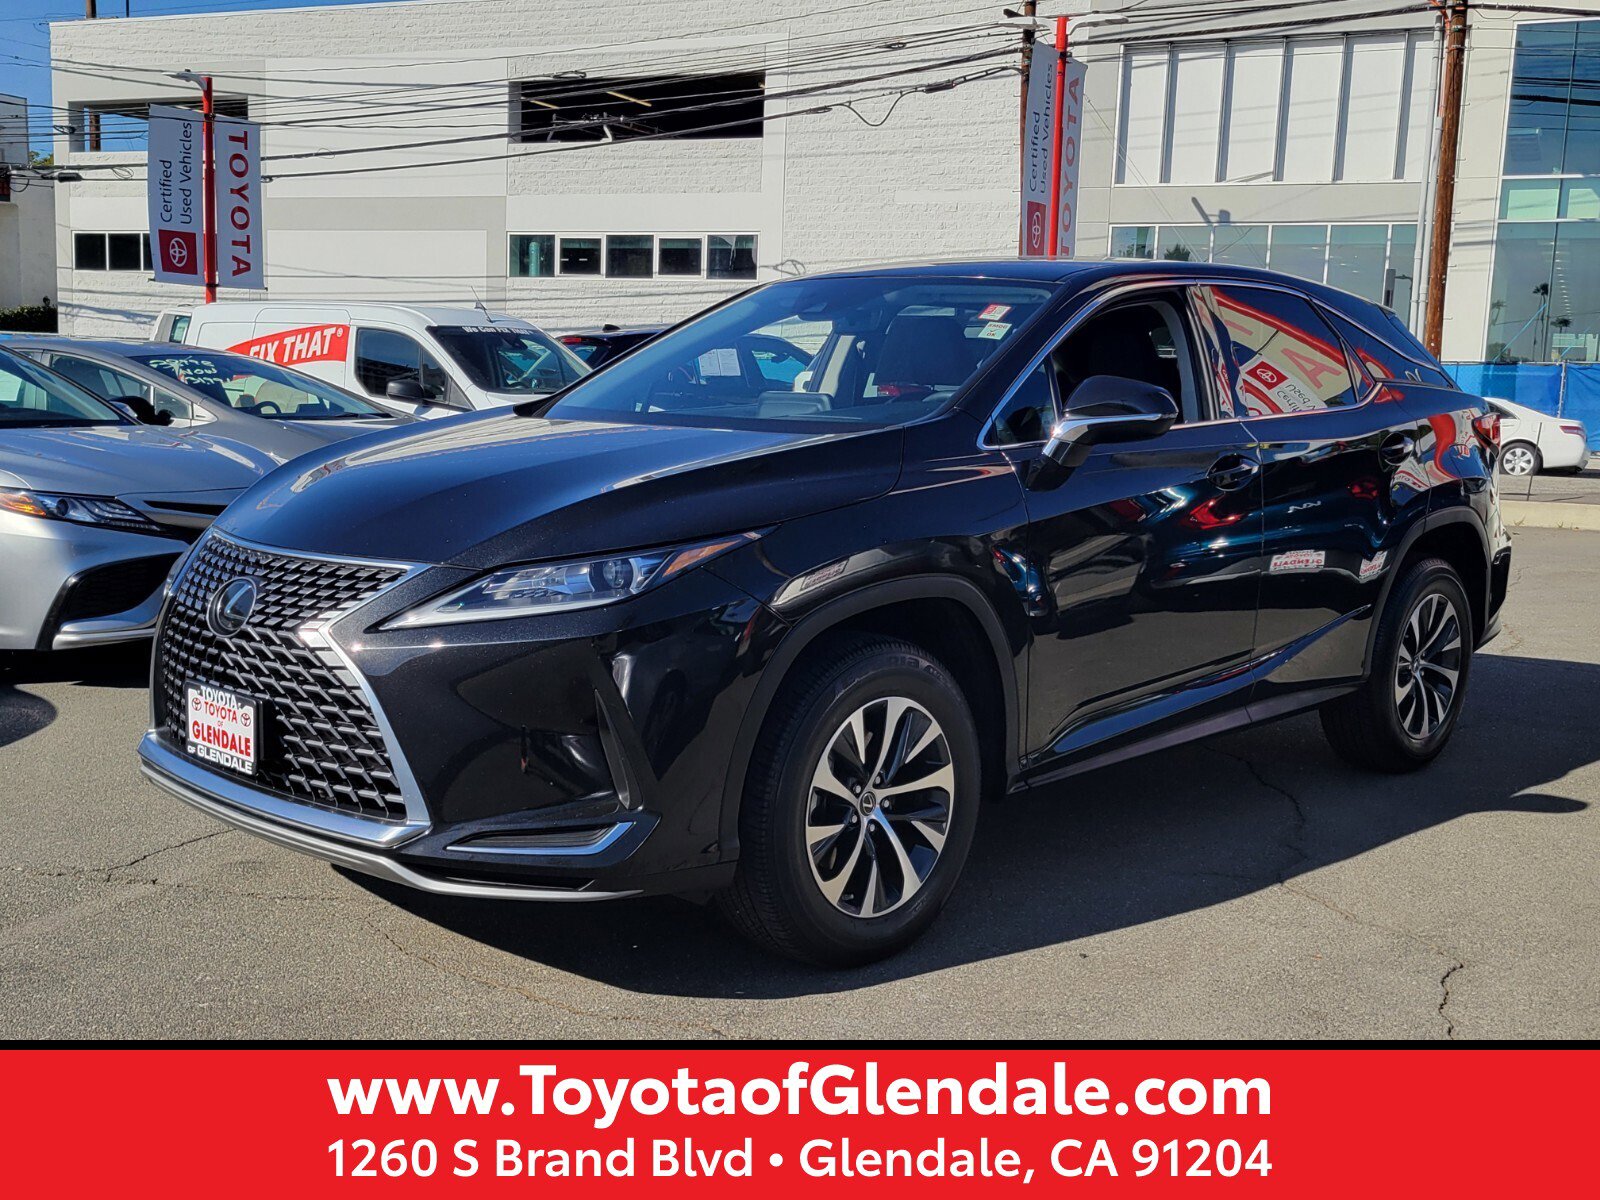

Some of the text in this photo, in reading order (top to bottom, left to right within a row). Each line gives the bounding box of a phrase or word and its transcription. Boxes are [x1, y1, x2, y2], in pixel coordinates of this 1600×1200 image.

[1042, 63, 1052, 141] Vehicles
[179, 122, 192, 225] Used Vehicles
[1030, 111, 1040, 192] Certified
[1061, 77, 1080, 256] TOYOTA
[159, 159, 172, 223] Certified
[228, 131, 251, 277] TOYOTA
[201, 685, 238, 710] TOYOTA
[204, 701, 238, 724] TOYOTA
[192, 720, 251, 757] GLENDALE
[197, 744, 252, 775] GLENDALE
